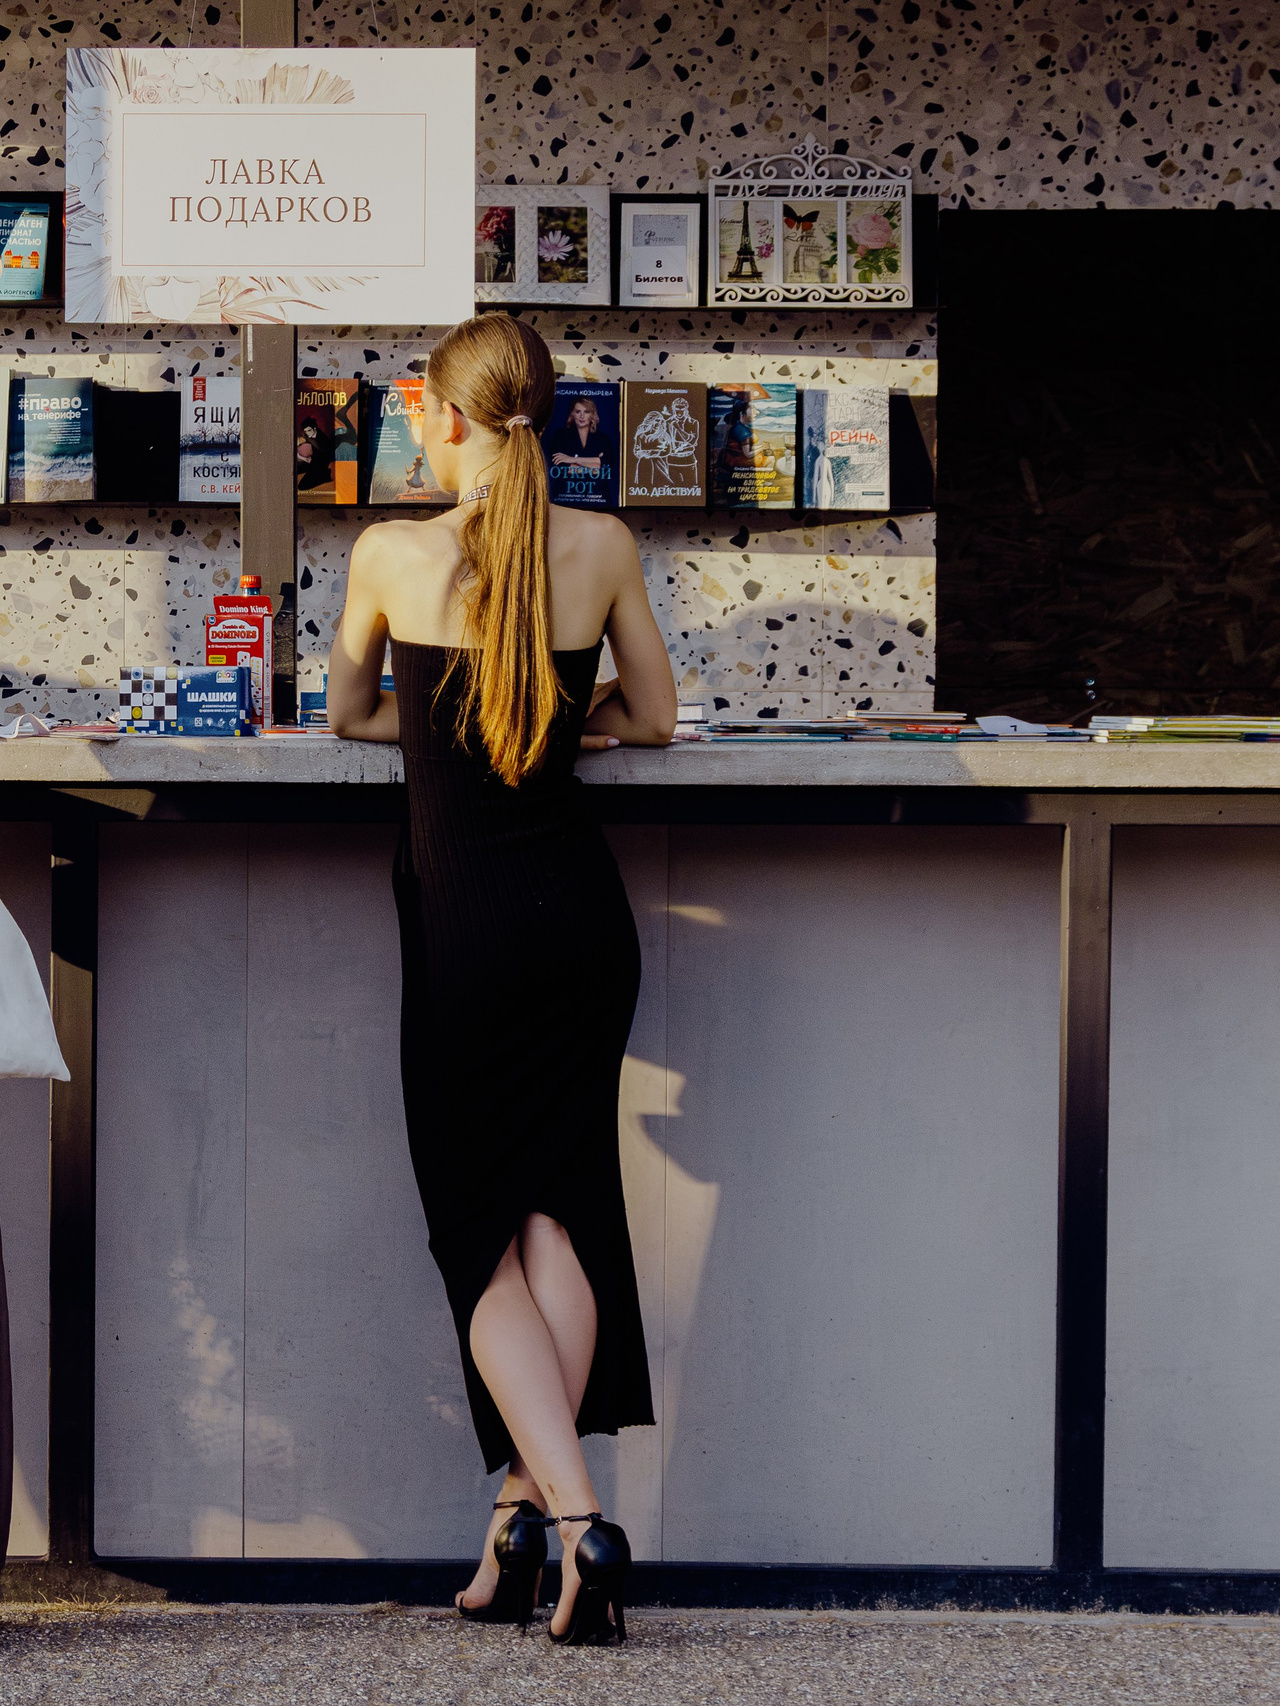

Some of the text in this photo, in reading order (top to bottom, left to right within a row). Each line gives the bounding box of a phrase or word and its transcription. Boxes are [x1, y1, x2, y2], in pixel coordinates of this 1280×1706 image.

[205, 158, 326, 185] ЛАВКА
[724, 184, 906, 200] Live Love Laugh
[169, 196, 373, 229] ПОДАРКОВ
[0, 238, 42, 246] СЧАСТЬЮ
[655, 259, 663, 269] 8
[635, 274, 684, 283] Билетов
[297, 391, 348, 406] УКЛОЛОВ
[193, 406, 240, 427] ЯЩИ
[830, 429, 882, 446] РЕЙНА,
[220, 450, 230, 462] С
[193, 465, 240, 478] КОСТЯ
[549, 464, 612, 479] ОТКРОЙ
[222, 482, 240, 494] КЕЙ
[566, 480, 597, 494] РОТ
[650, 485, 702, 498] ДЕЙСТВУЙ!
[219, 605, 269, 614] Domino King
[210, 630, 257, 640] DOMINOES
[186, 692, 237, 703] ШАШКИ
